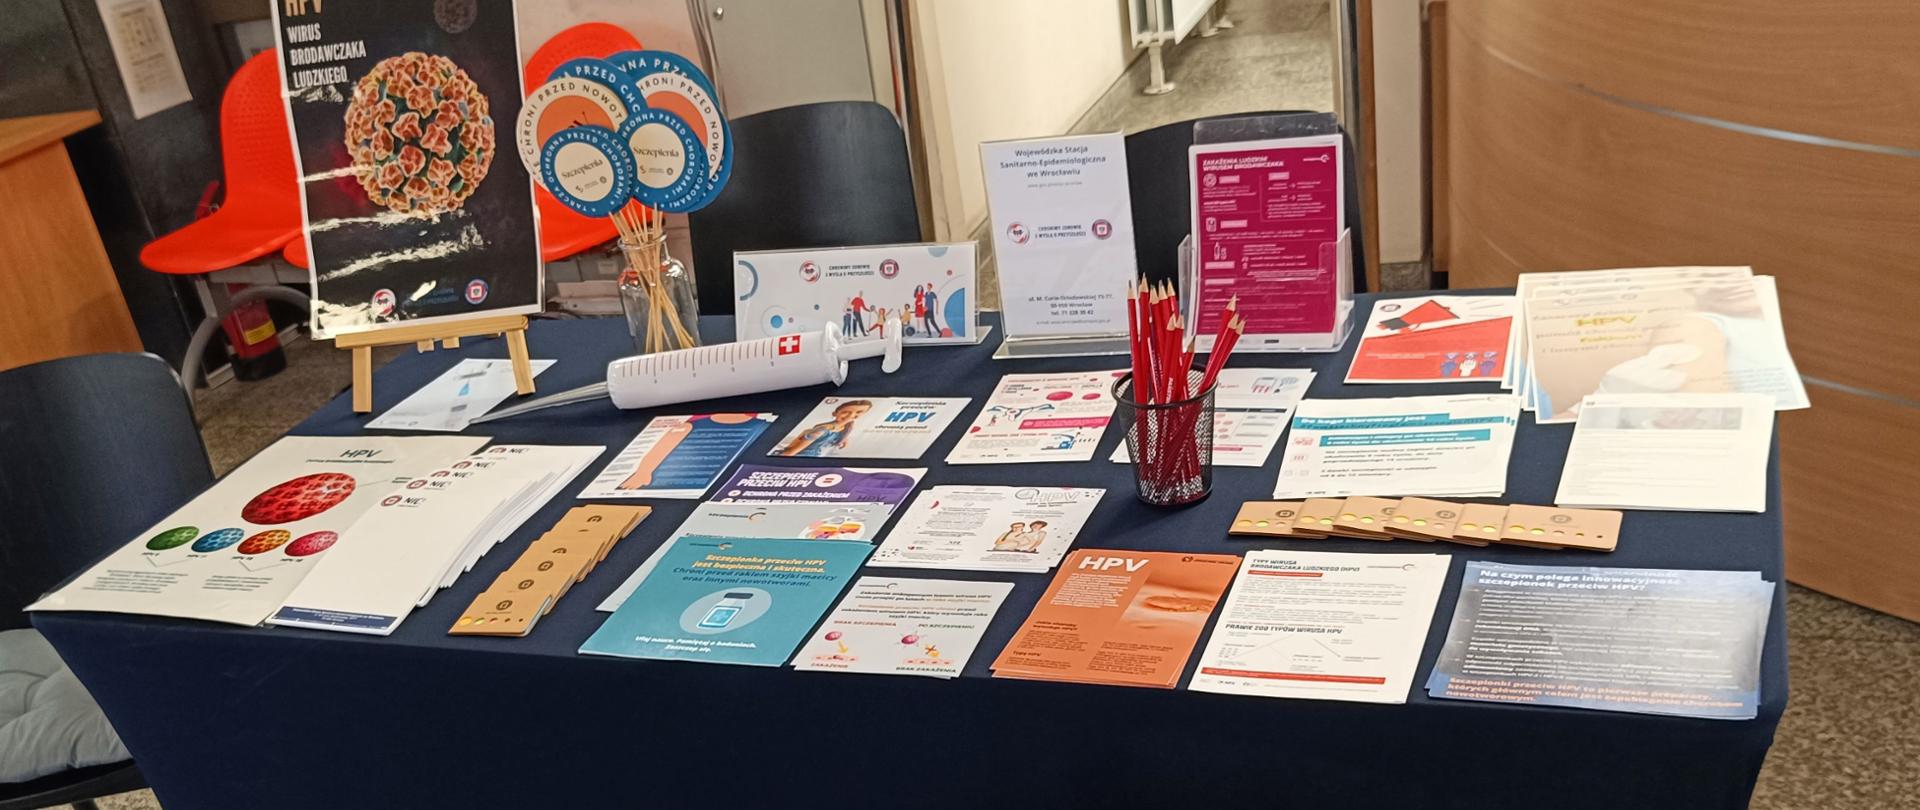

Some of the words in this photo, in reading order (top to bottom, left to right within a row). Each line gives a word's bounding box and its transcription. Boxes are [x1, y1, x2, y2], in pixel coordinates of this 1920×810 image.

[286, 23, 322, 43] WIRUS
[289, 40, 367, 66] BRODAWCZAKA
[292, 65, 349, 89] LUDZKIEGO
[574, 65, 617, 84] PRZED
[679, 80, 712, 115] PRZED
[523, 103, 539, 156] CHRONI
[538, 81, 577, 102] PRZED
[659, 112, 687, 136] PRZED
[566, 131, 599, 145] PRZED
[1015, 146, 1063, 158] Wojewódzka
[1064, 146, 1088, 155] Stacja
[544, 135, 566, 184] OCHRONNA
[1000, 155, 1107, 169] Sanitarno-Epidemiologiczna
[601, 142, 625, 200] CHOROBAMI
[671, 138, 696, 197] CHOROBAMI
[1027, 171, 1039, 179] we
[1040, 169, 1081, 178] Wrocławiu
[553, 185, 588, 213] TARCZA
[884, 411, 937, 423] HPV
[340, 449, 382, 458] HPV
[736, 478, 786, 488] PRZECIW
[786, 479, 813, 488] HPV
[748, 471, 820, 481] SZCZEPIENIE
[692, 560, 713, 568] jest
[713, 562, 767, 570] bezpieczna
[705, 553, 764, 563] Szczepionka
[1077, 555, 1150, 573] HPV
[1250, 563, 1302, 571] BRODAWCZAKA
[673, 567, 705, 575] Chroni
[771, 572, 800, 580] szyjki
[800, 574, 838, 582] macicy
[704, 576, 740, 585] innymi
[740, 578, 812, 587] nowotworami.
[1479, 569, 1498, 578] Na
[1500, 572, 1534, 581] czym
[1535, 573, 1580, 583] polega
[1477, 578, 1555, 589] szczepionek
[1557, 581, 1610, 591] przeciw
[1611, 584, 1647, 592] HPV?
[1225, 623, 1254, 631] PRAWIE
[1270, 625, 1297, 633] TYPÓW
[1446, 683, 1489, 692] których
[1490, 686, 1543, 696] głównym
[1450, 677, 1512, 687] Szczepionki
[1512, 681, 1556, 690] przeciw
[1445, 690, 1537, 702] nowotworowym.
